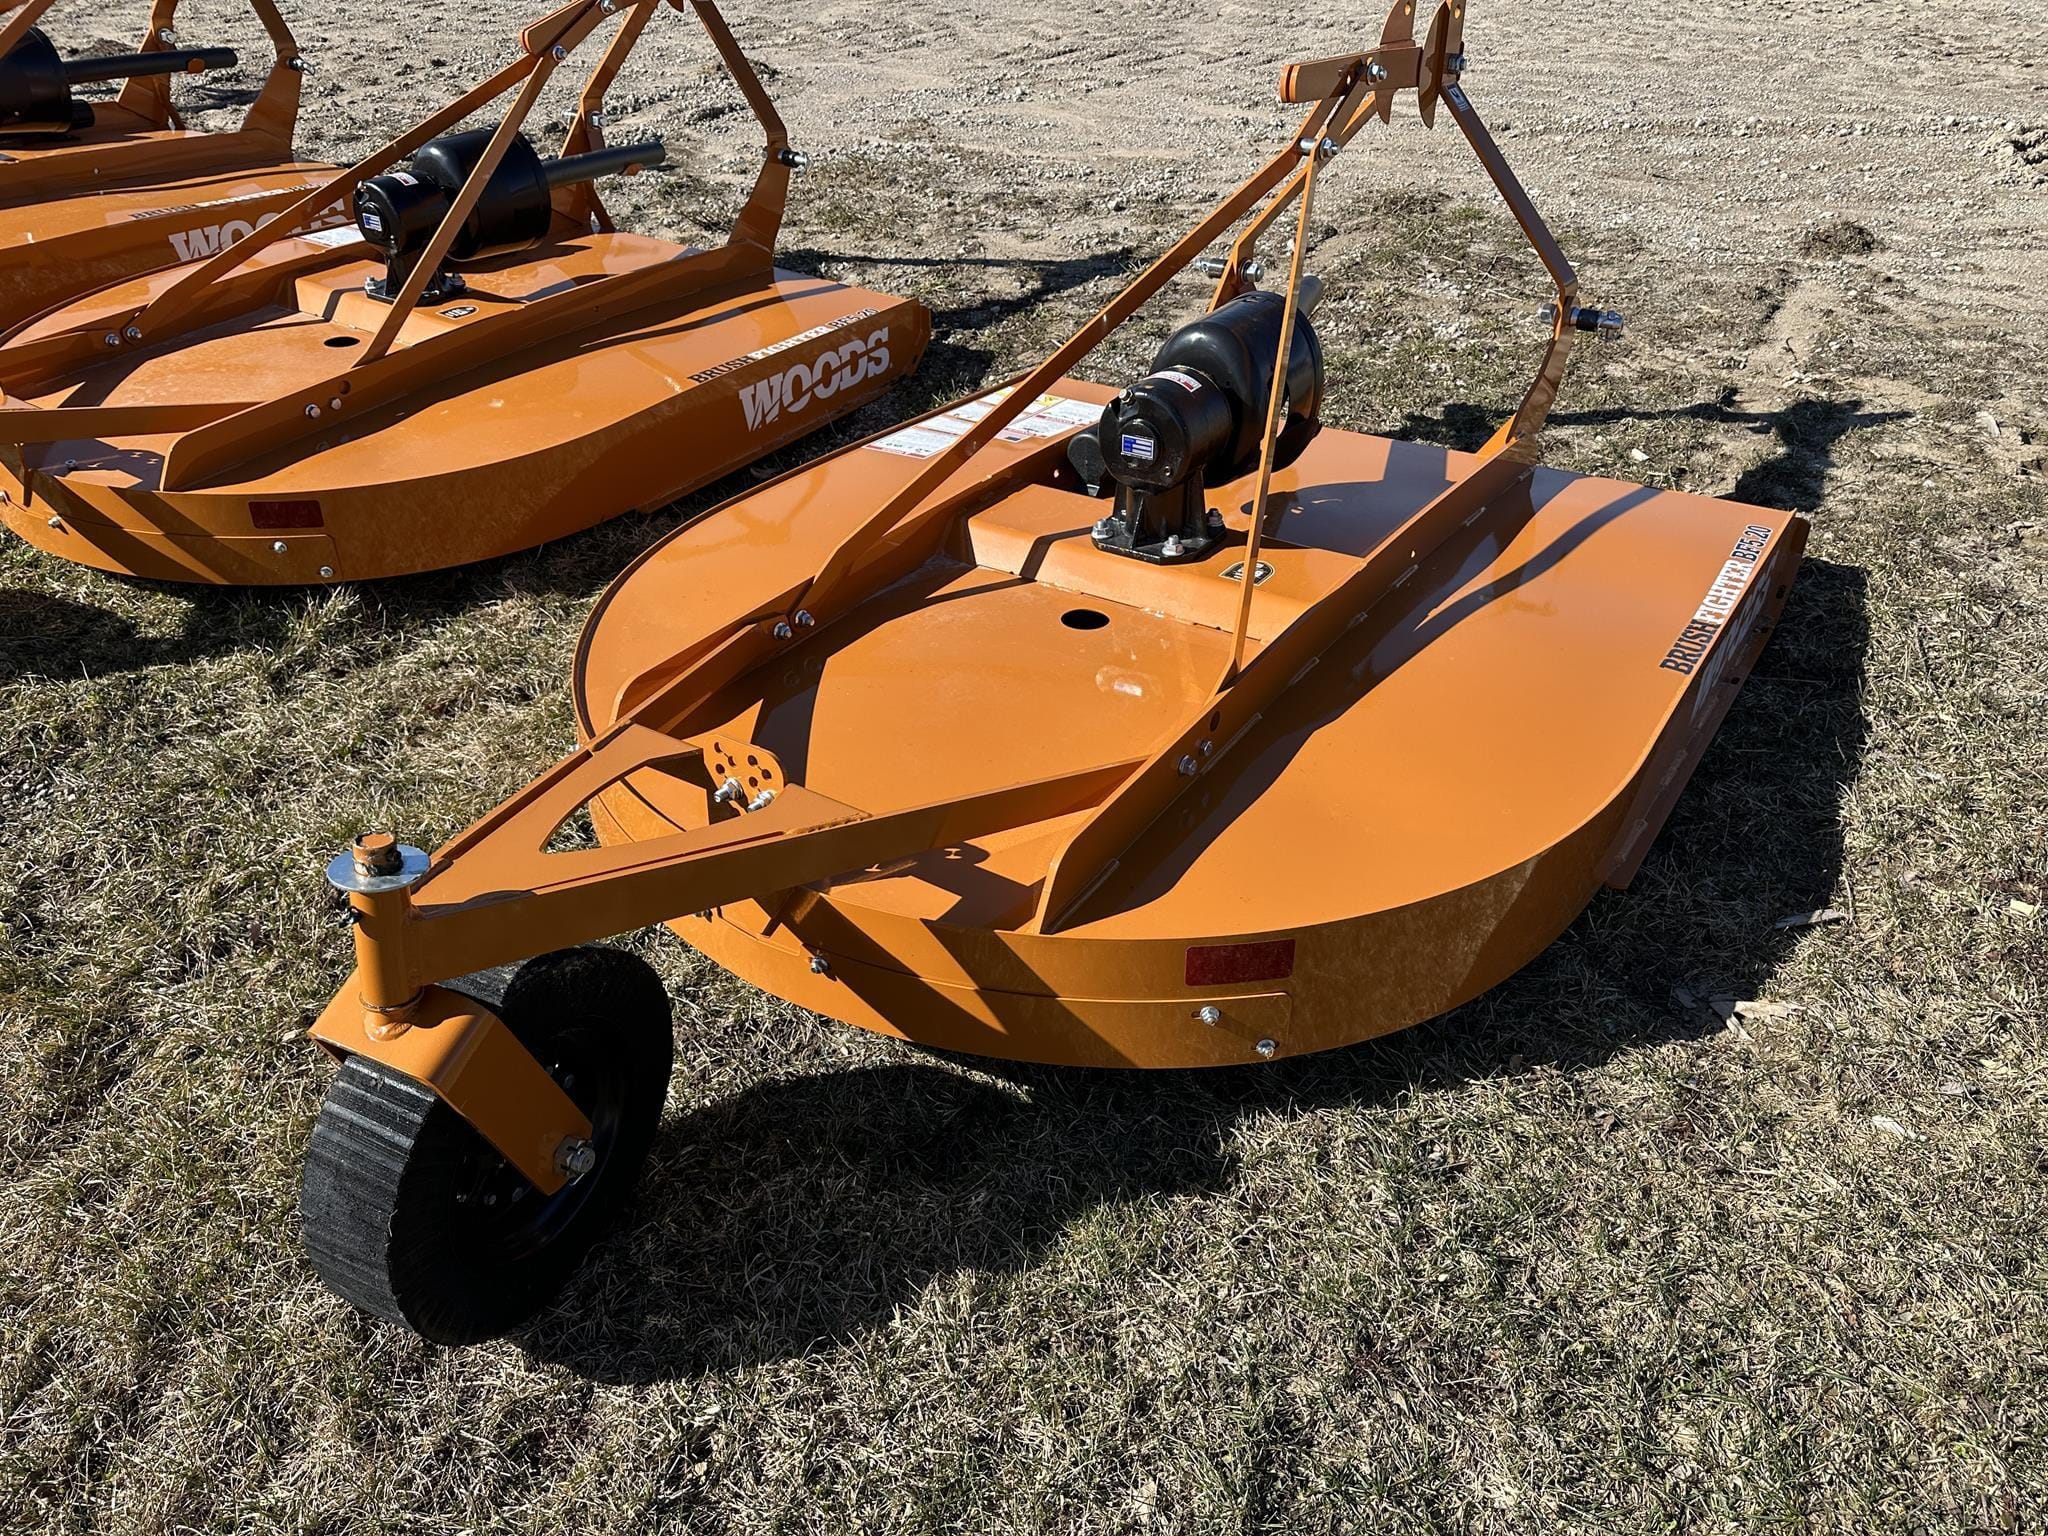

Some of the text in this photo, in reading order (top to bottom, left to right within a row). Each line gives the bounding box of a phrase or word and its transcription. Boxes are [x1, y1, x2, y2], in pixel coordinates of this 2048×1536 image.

[687, 355, 756, 385] BRUSH
[738, 326, 892, 432] WOODS
[1659, 524, 1773, 676] BRUSH FIGHTER BF5.20
